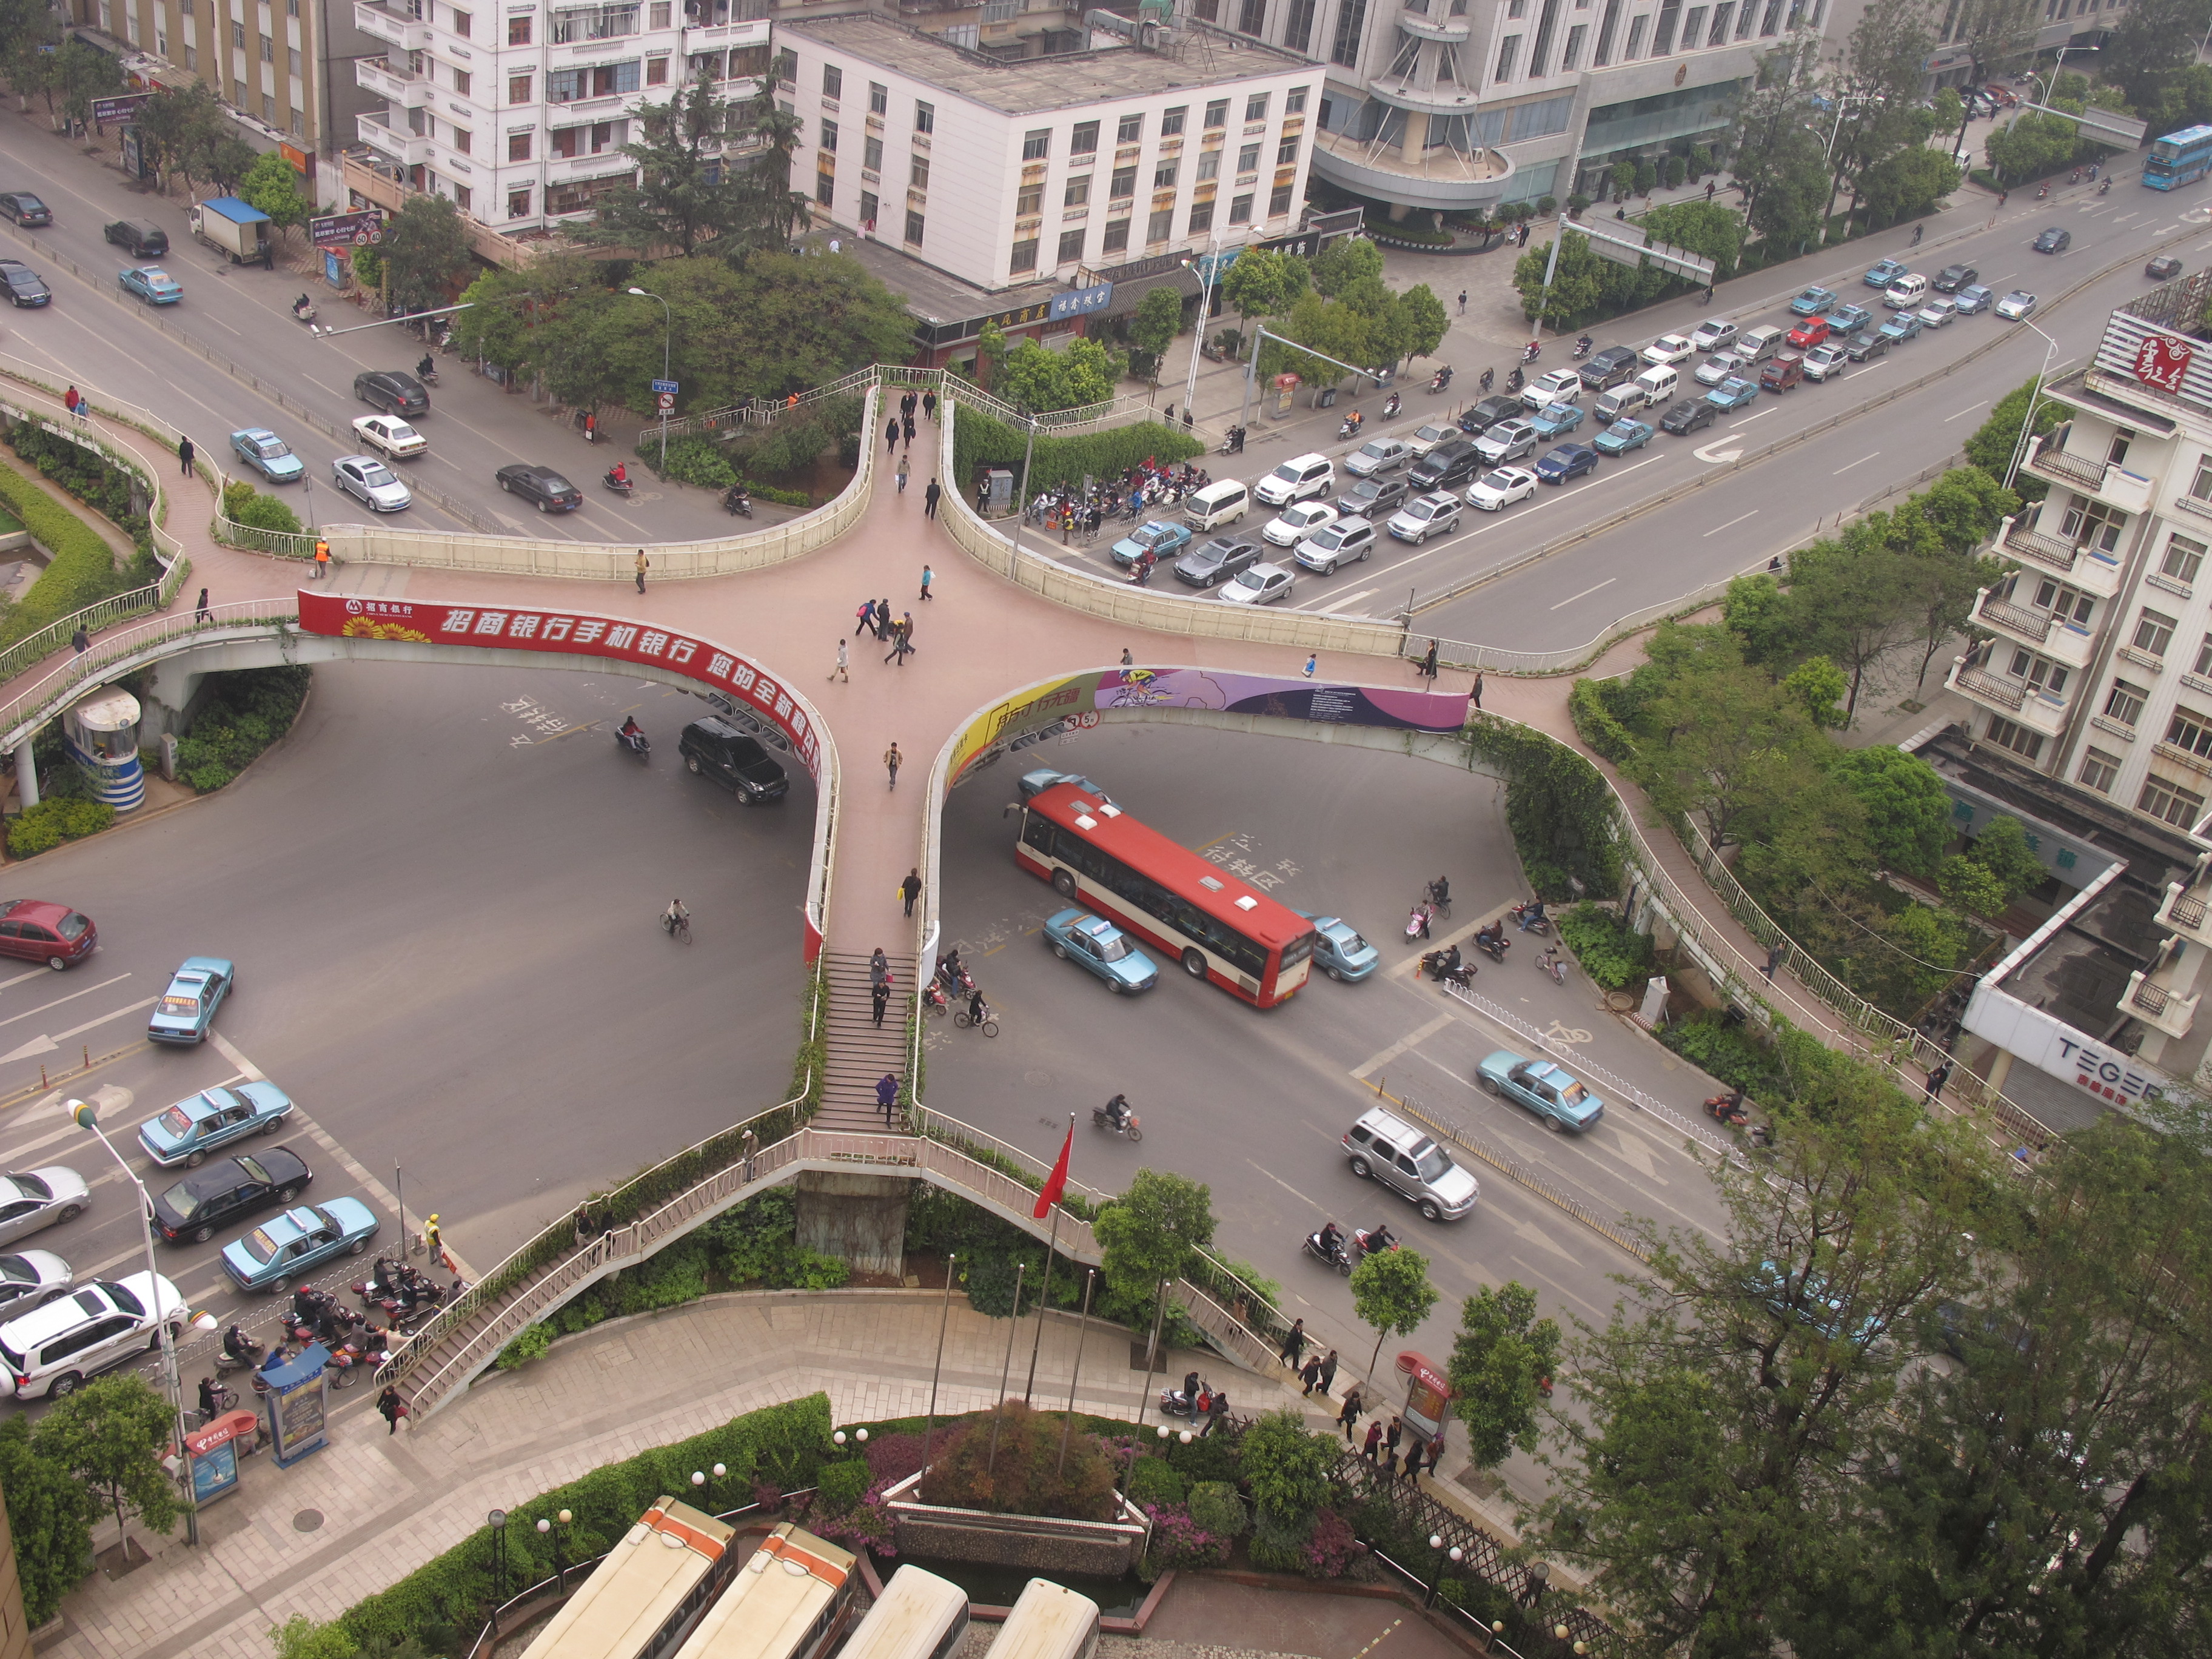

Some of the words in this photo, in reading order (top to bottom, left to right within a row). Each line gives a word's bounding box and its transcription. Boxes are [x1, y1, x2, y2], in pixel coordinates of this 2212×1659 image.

[366, 602, 413, 614] 招商银行
[2059, 1036, 2165, 1101] TEGER
[2076, 1073, 2128, 1107] 泰格服饰
[207, 1427, 229, 1443] 中国电信
